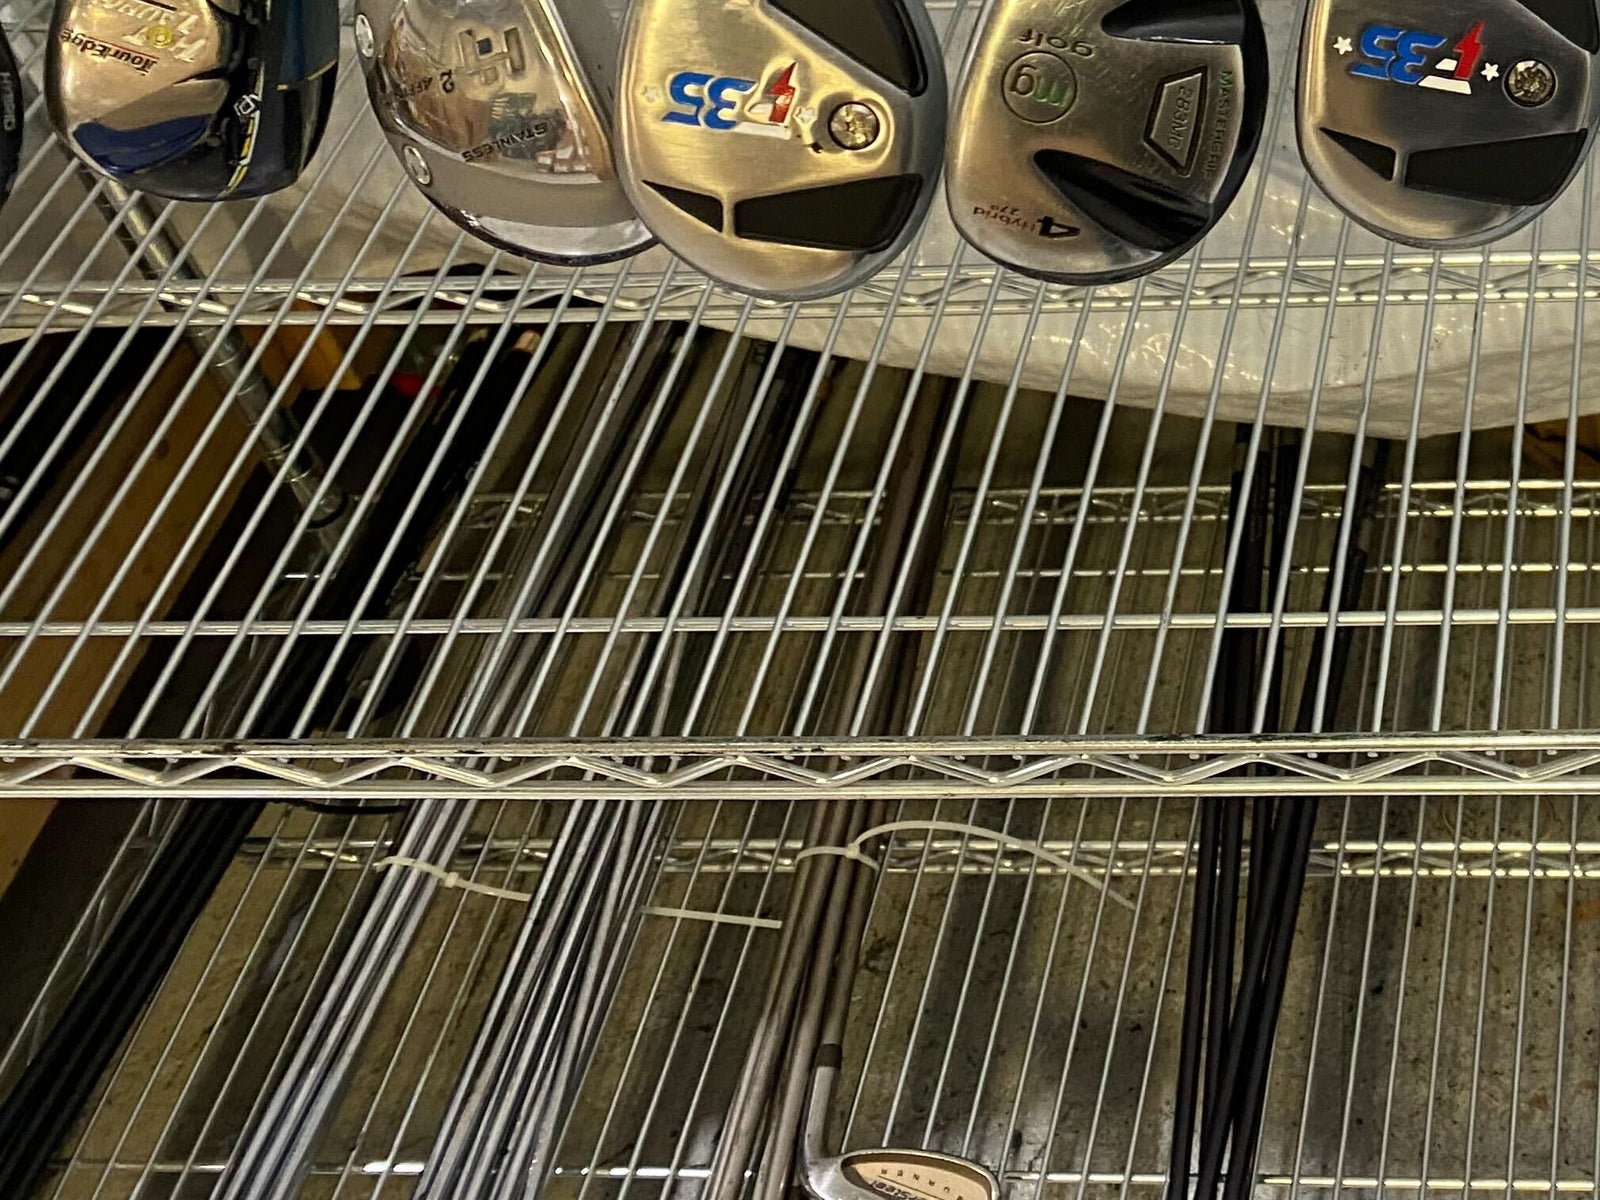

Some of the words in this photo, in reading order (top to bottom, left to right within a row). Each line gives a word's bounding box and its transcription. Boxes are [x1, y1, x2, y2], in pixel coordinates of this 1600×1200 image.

[1016, 28, 1096, 58] golf
[462, 120, 549, 163] STAINLESS
[973, 205, 1037, 232] Hybrid
[1037, 215, 1081, 240] 4
